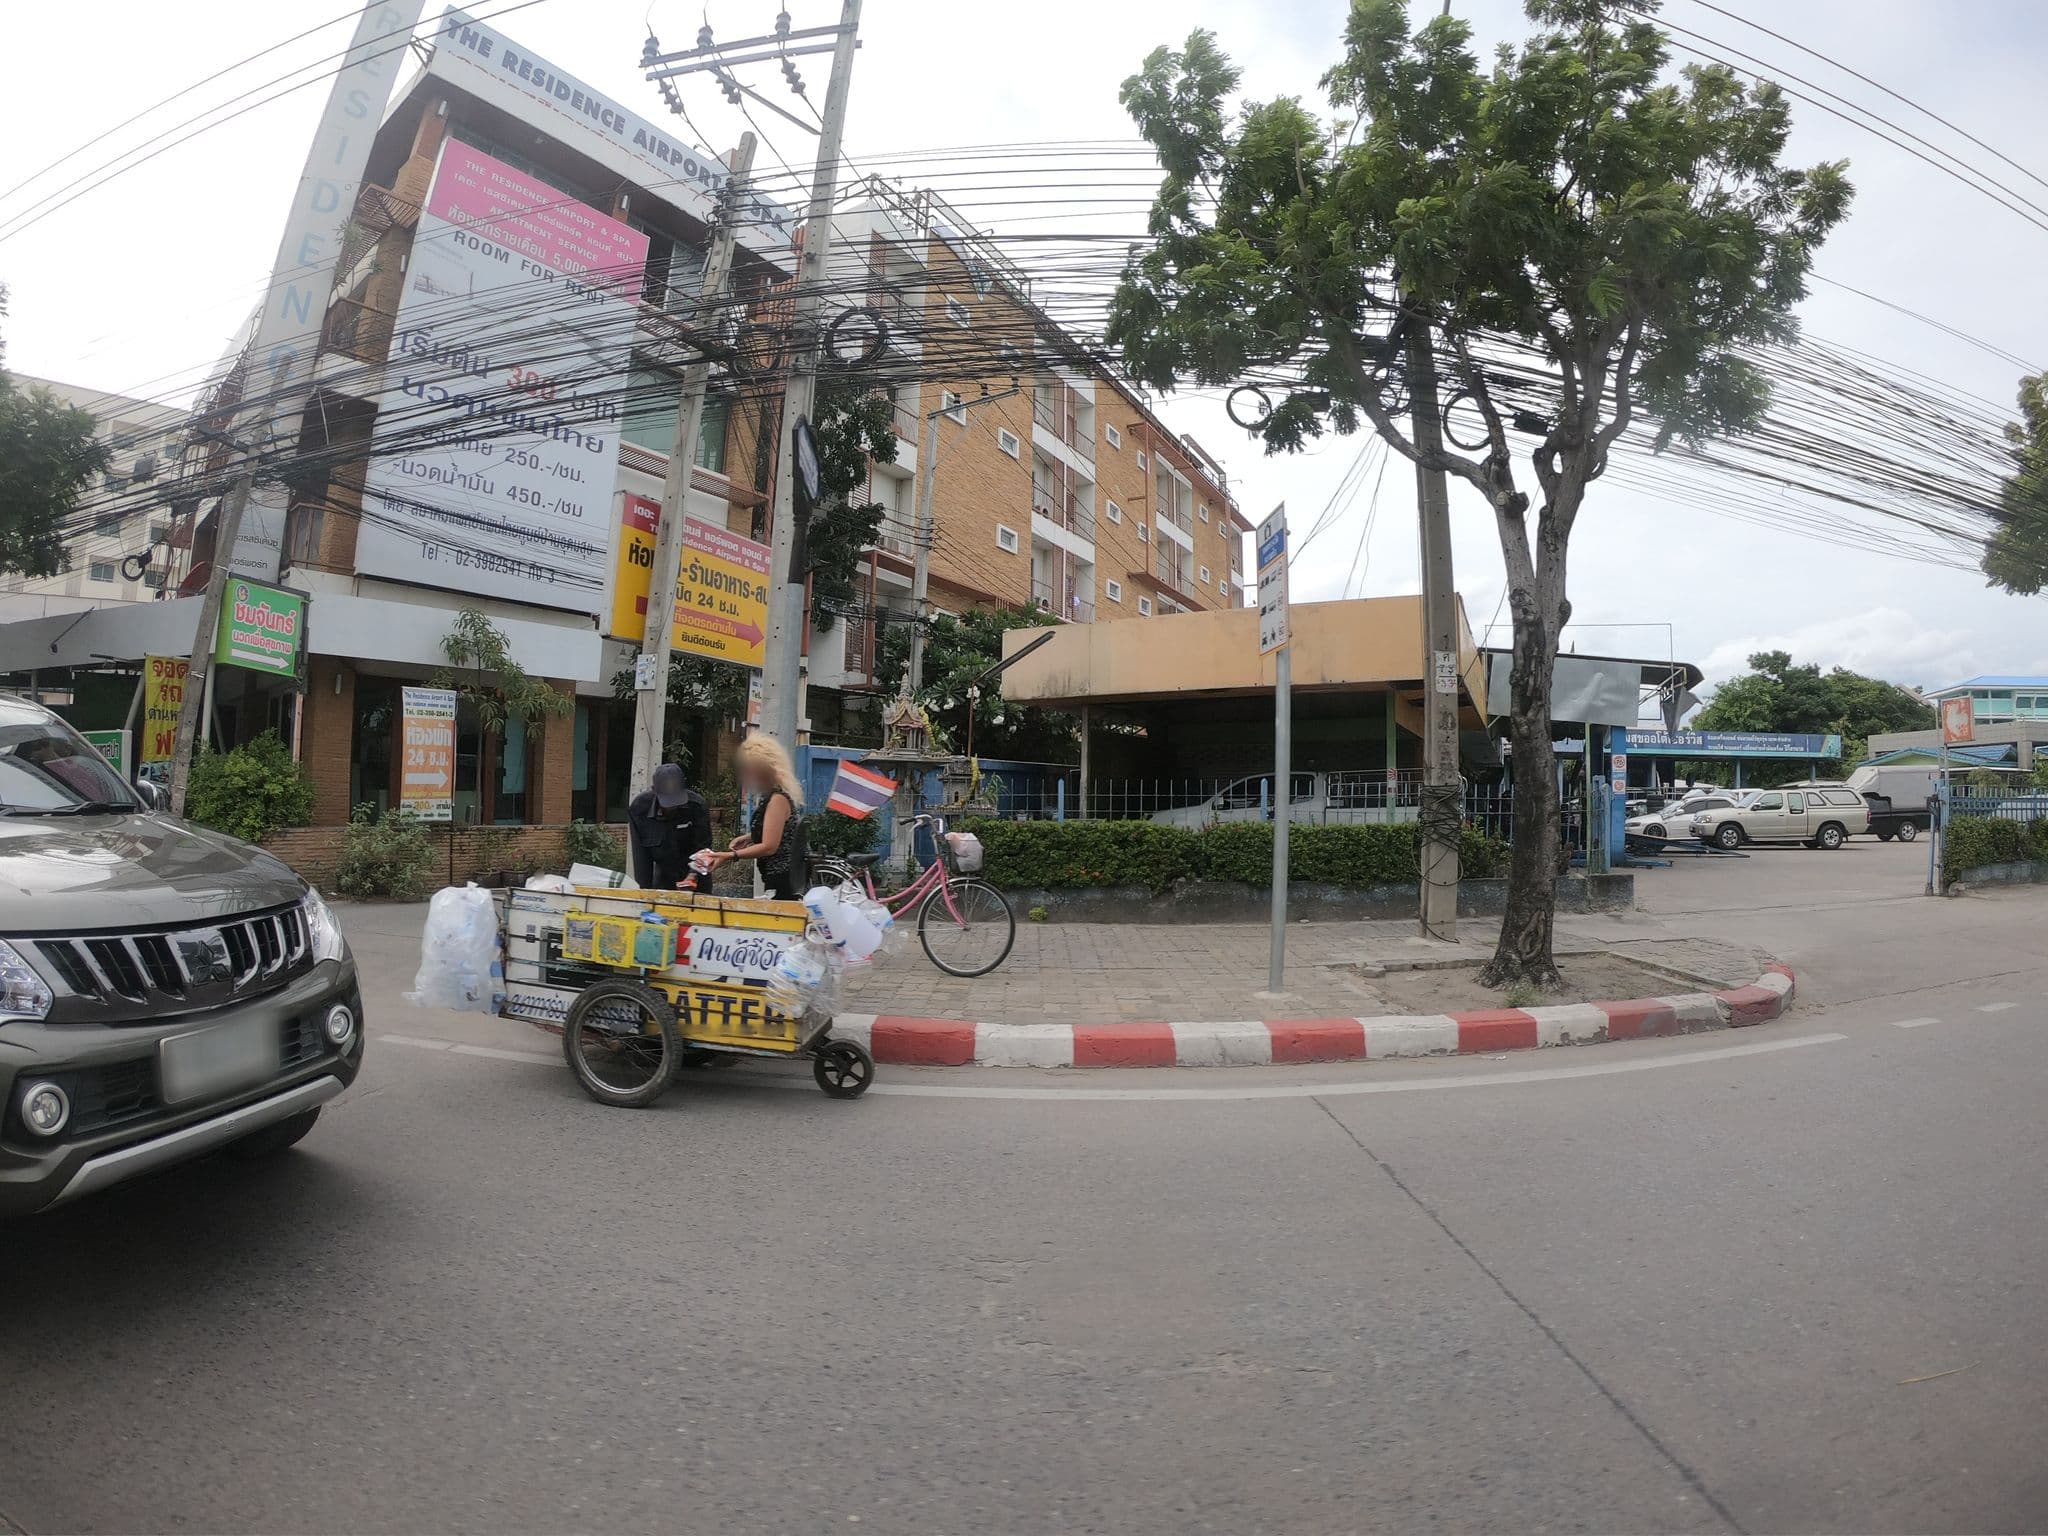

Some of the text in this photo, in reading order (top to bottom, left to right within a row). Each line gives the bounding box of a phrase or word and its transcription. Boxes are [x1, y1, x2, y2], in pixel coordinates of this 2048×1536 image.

[447, 18, 495, 58] THE
[501, 49, 626, 136] RESIDENCE
[633, 128, 722, 190] AIRPORT
[465, 160, 631, 247] THE RESIDENCE AIRPORT & SPA
[489, 207, 601, 262] APARTMENT SERVICE
[454, 230, 607, 306] ROOM FOR RENT
[616, 250, 634, 264] สปา
[505, 447, 586, 484] 250.-/ชม.
[633, 504, 656, 520] เดอะ
[421, 541, 439, 561] Tel
[715, 548, 742, 565] Airport
[752, 561, 766, 573] Spa
[697, 592, 714, 608] 24
[235, 602, 297, 635] ชมจันทร์
[232, 629, 293, 655] นวดเพื่อสุขภาพ
[152, 660, 190, 679] จอด
[160, 684, 183, 703] รถ
[148, 705, 178, 722] ด้านห
[408, 748, 426, 766] 24
